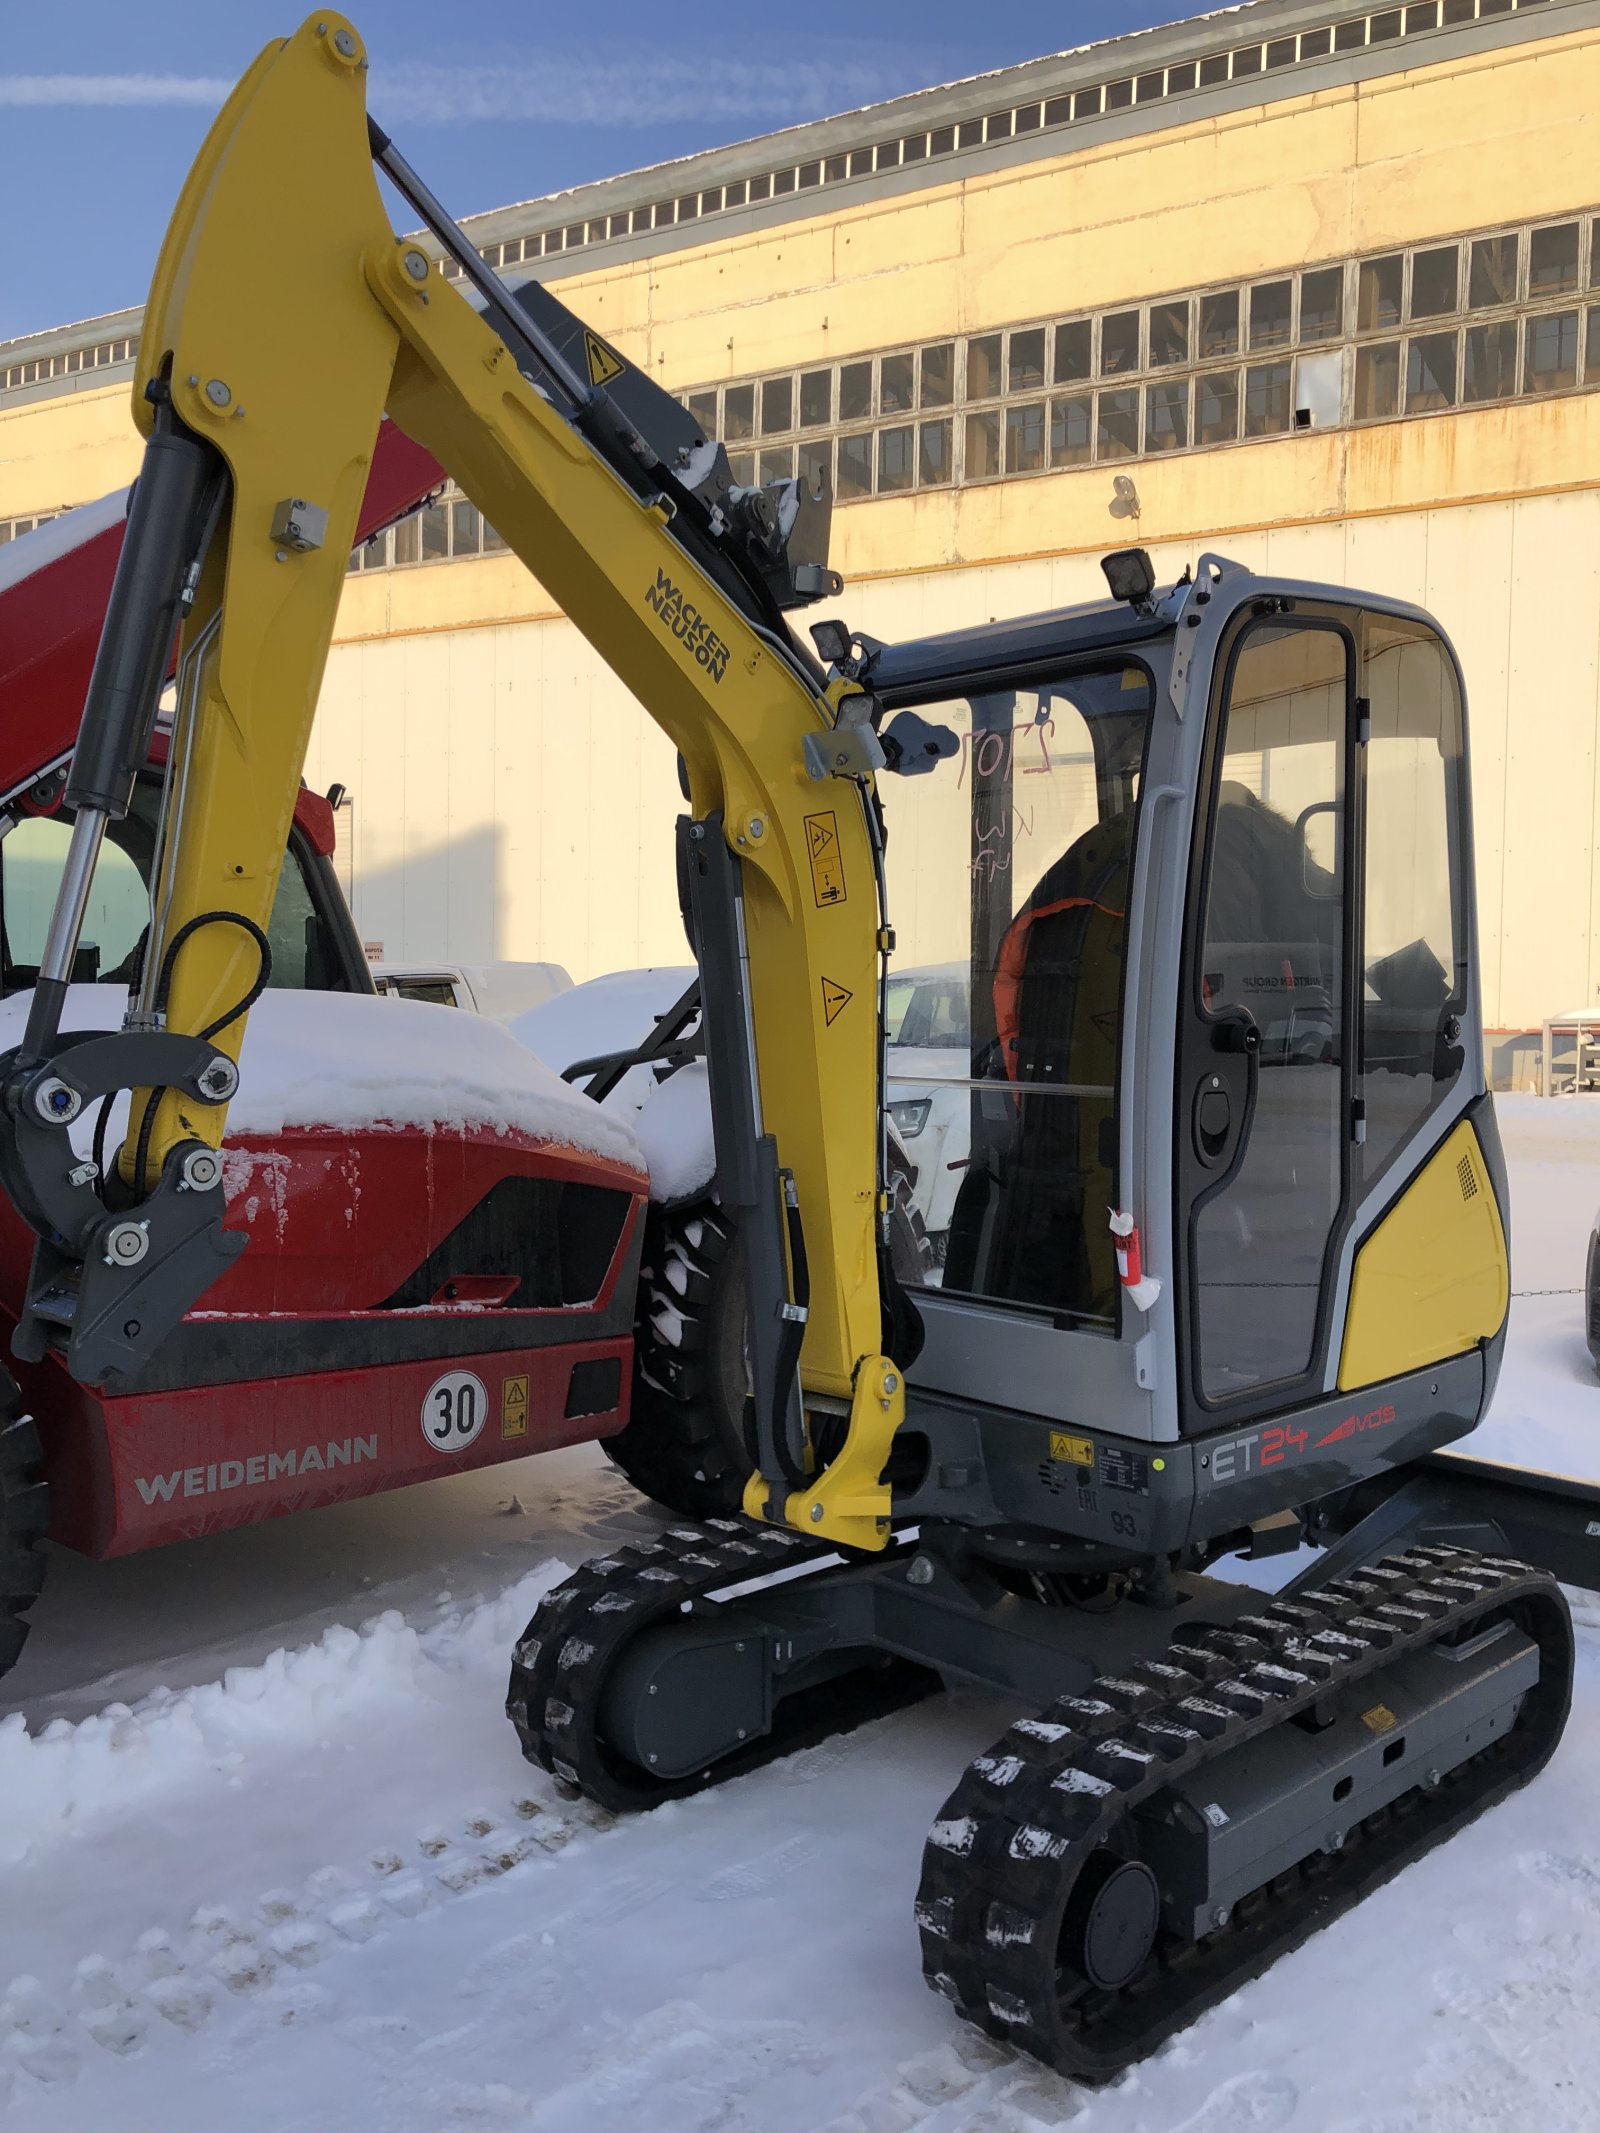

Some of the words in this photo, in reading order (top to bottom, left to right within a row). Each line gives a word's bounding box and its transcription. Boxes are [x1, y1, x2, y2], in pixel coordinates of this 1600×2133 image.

[645, 585, 726, 685] NEUSON
[656, 566, 731, 667] WACKER
[433, 1383, 476, 1439] 30
[134, 1433, 379, 1505] WEIDEMANN
[1111, 1510, 1137, 1537] 93
